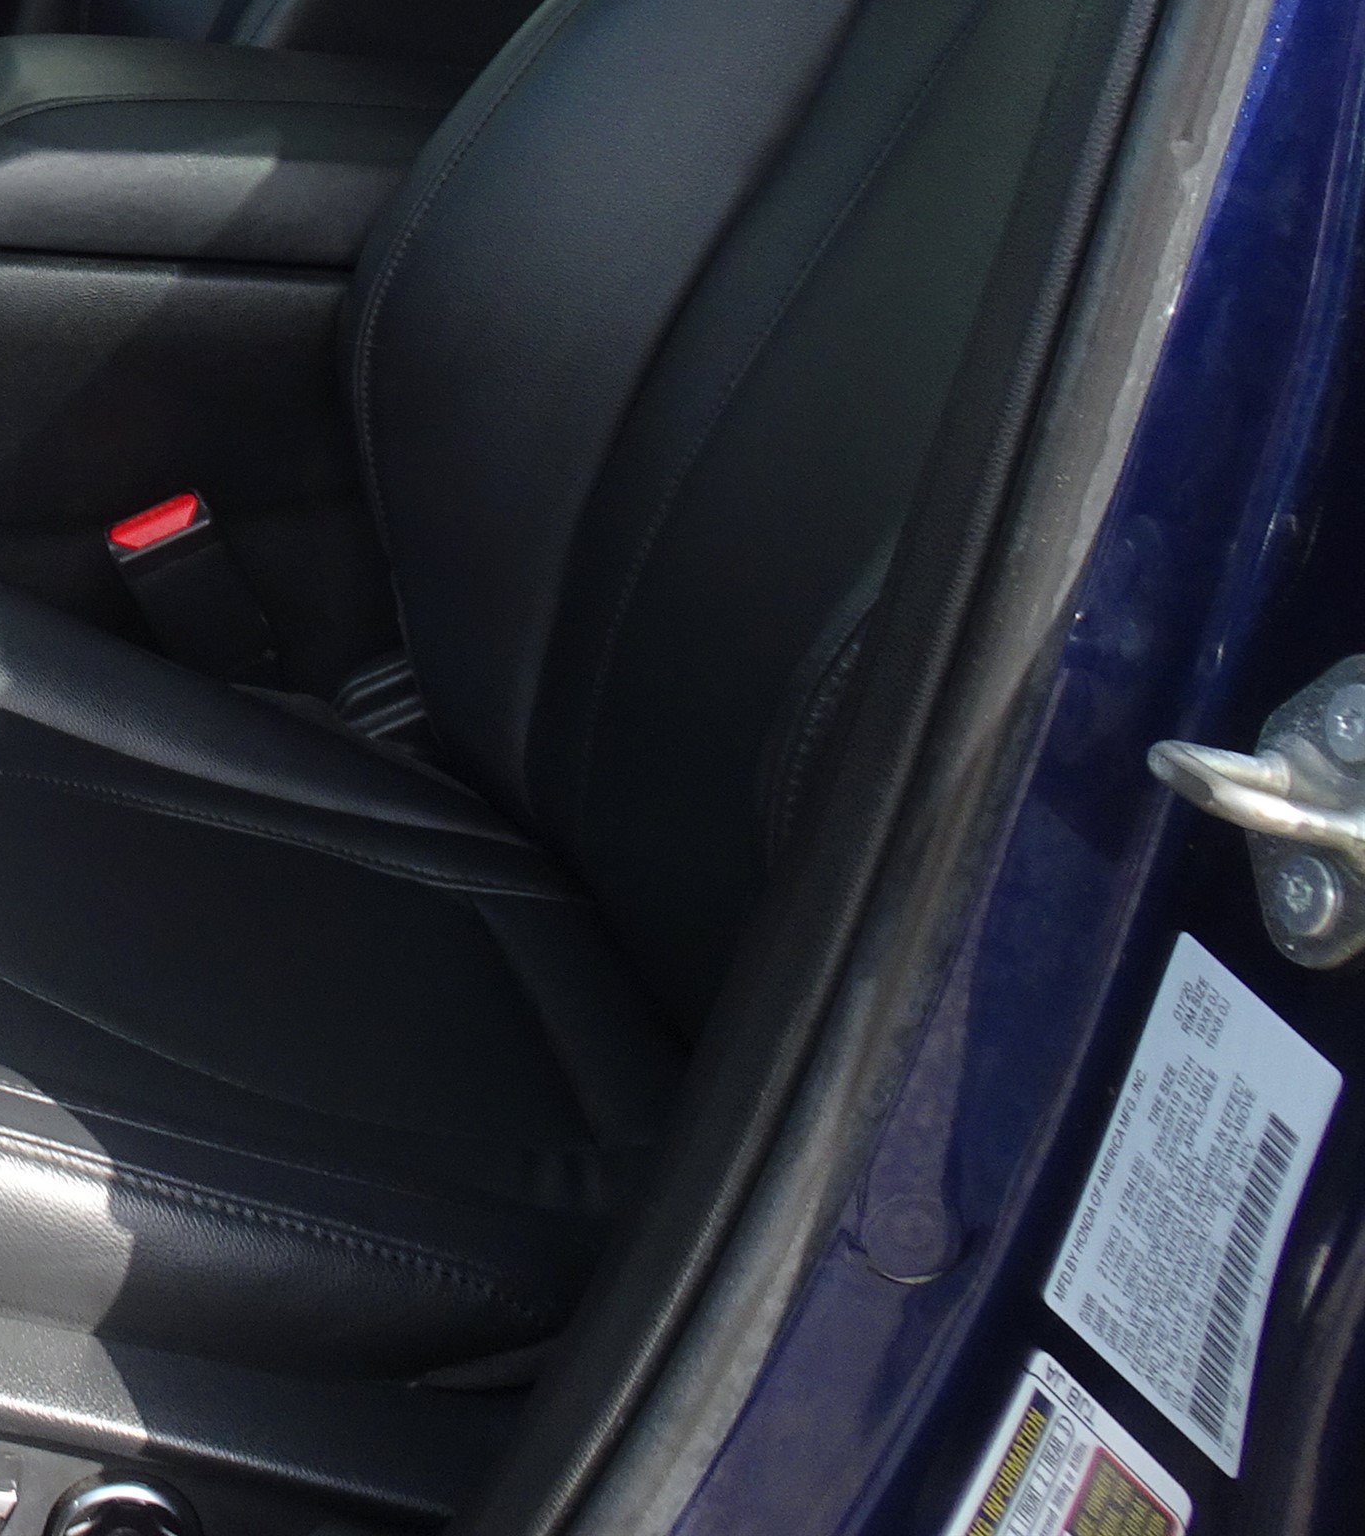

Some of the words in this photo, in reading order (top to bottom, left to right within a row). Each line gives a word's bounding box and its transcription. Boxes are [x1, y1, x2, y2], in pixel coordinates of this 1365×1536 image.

[1179, 1005, 1198, 1037] RIM
[1182, 1066, 1220, 1154] APPLICABLE
[1219, 1070, 1247, 1132] EFFECT
[1095, 1124, 1126, 1189] AMERICA
[1088, 1182, 1105, 1209] OF
[1071, 1201, 1098, 1255] HONDA
[980, 1401, 1048, 1527] INFORMATION
